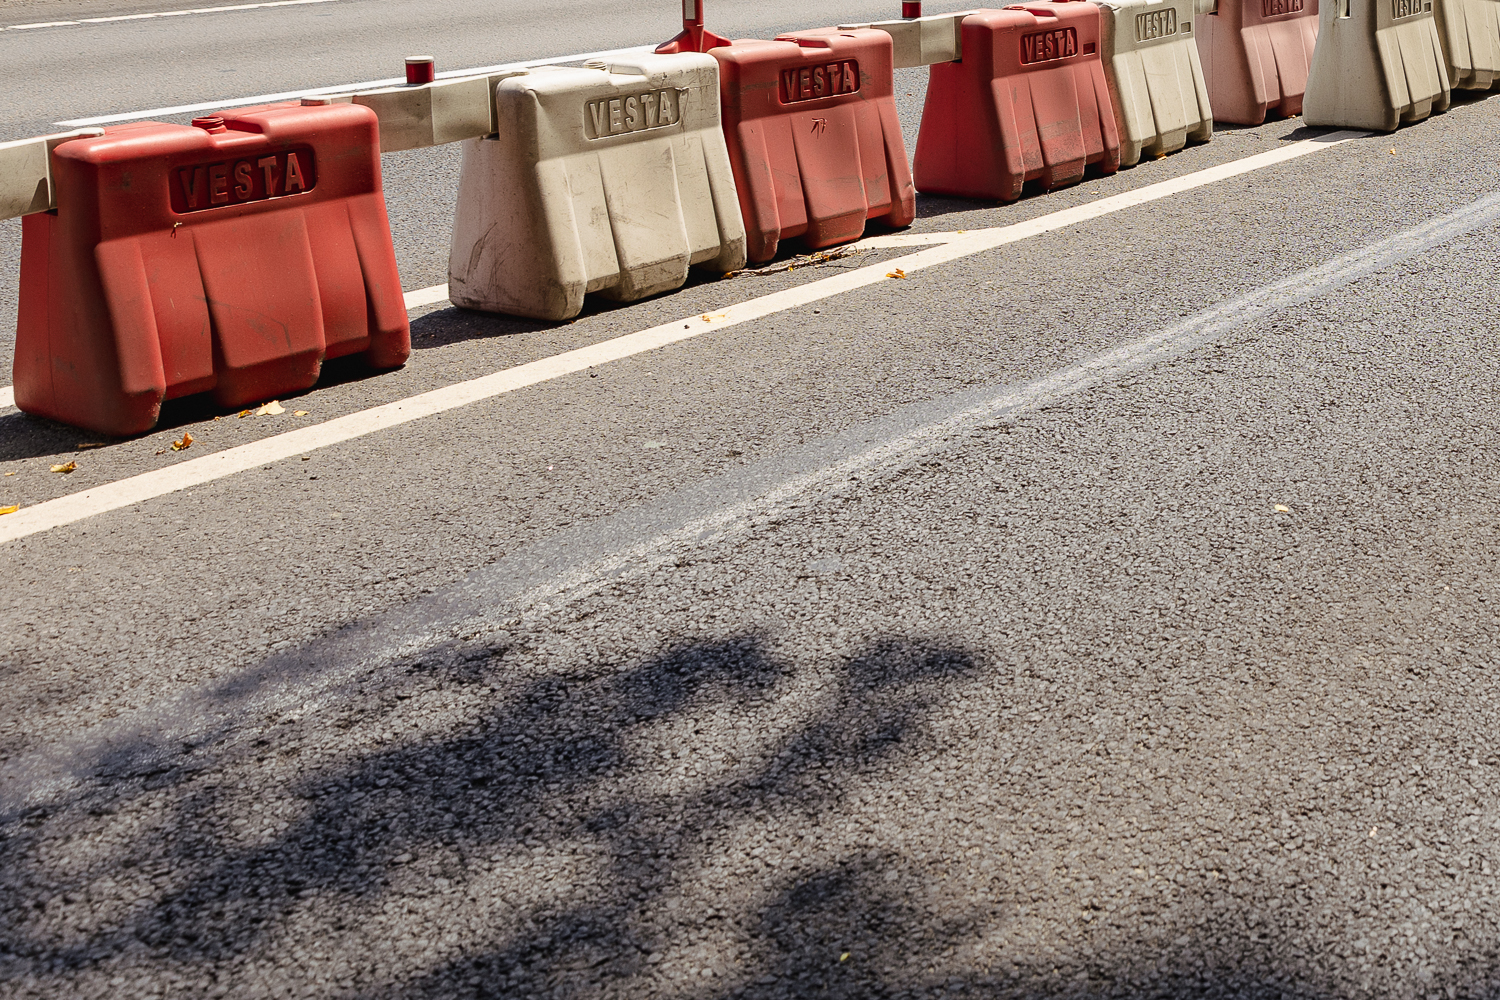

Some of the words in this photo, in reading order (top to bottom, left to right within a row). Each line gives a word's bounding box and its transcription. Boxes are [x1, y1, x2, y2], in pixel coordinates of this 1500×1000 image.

[1137, 10, 1175, 41] VESTA
[1024, 29, 1075, 61] VESTA
[784, 62, 855, 100] VESTA
[589, 91, 672, 135] VESTA
[180, 152, 305, 208] VESTA
